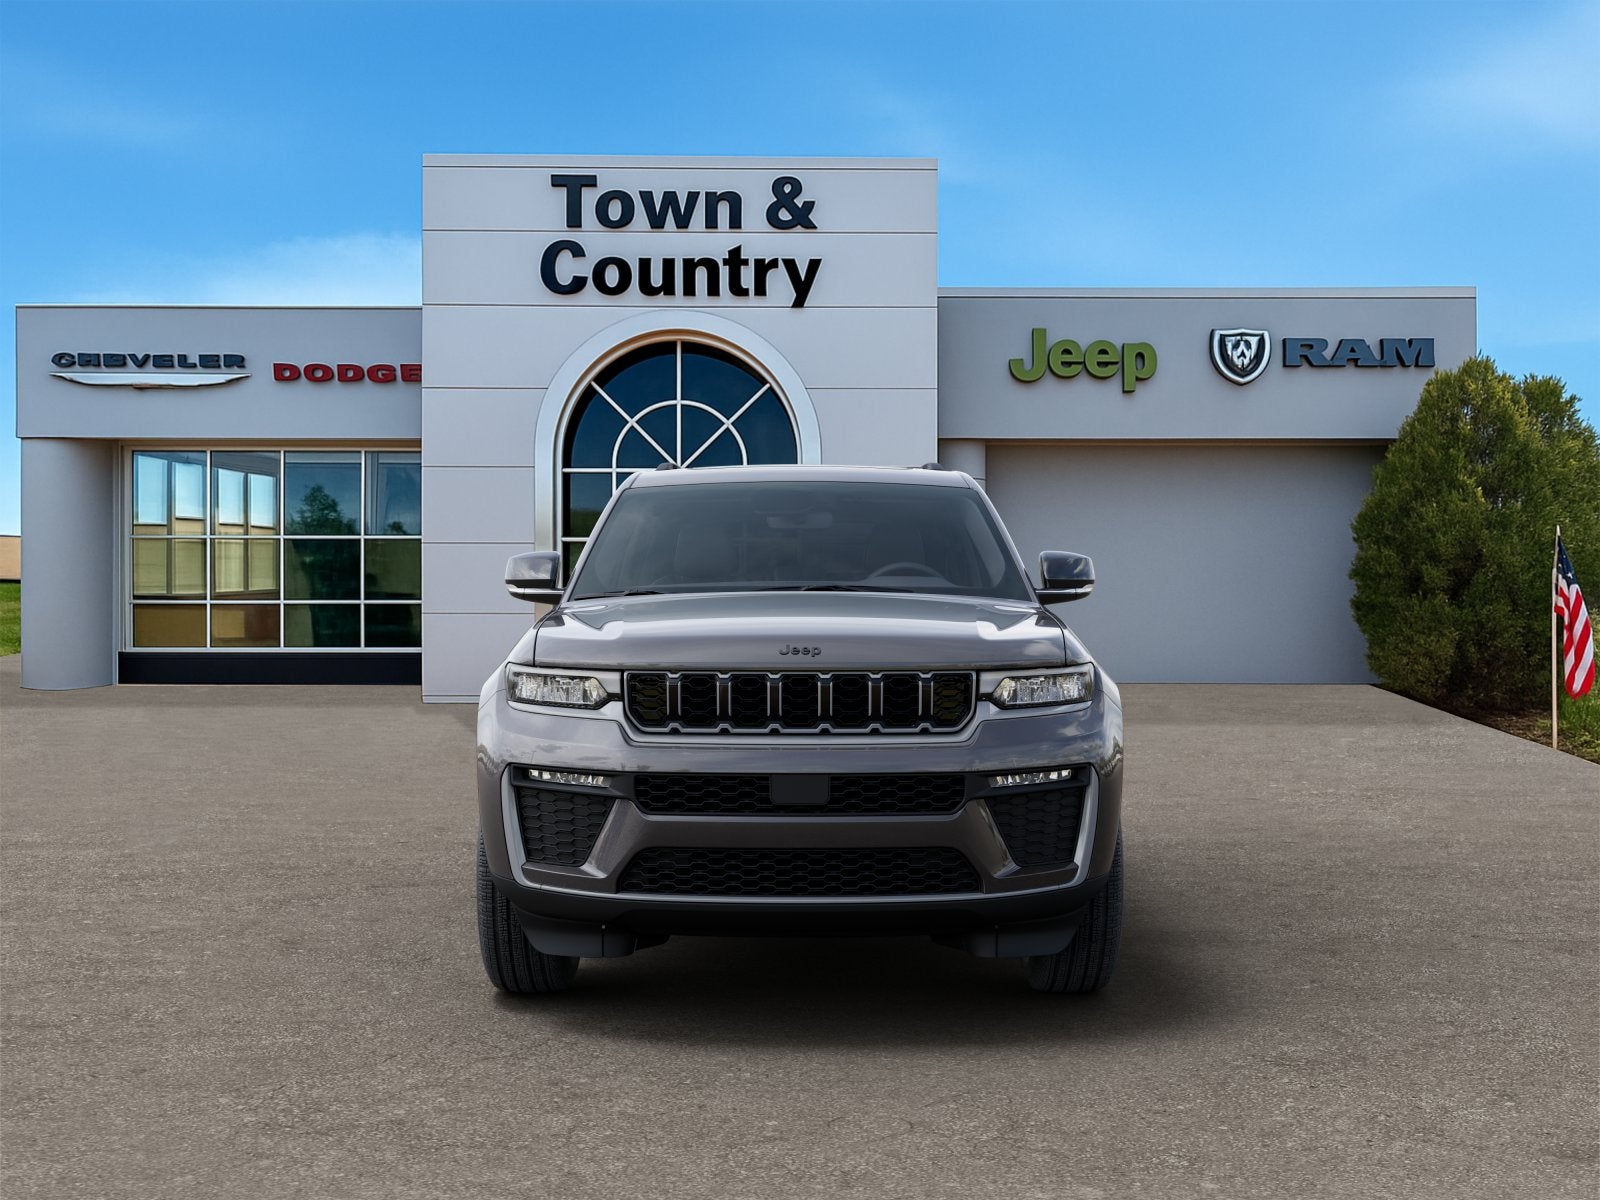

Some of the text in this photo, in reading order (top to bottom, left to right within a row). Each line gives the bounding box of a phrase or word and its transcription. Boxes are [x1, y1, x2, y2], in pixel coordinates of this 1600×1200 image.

[551, 174, 817, 229] Town &
[540, 239, 822, 307] Country
[1009, 328, 1157, 393] Jeep
[1283, 338, 1435, 367] RAM
[779, 644, 821, 657] Jeep
